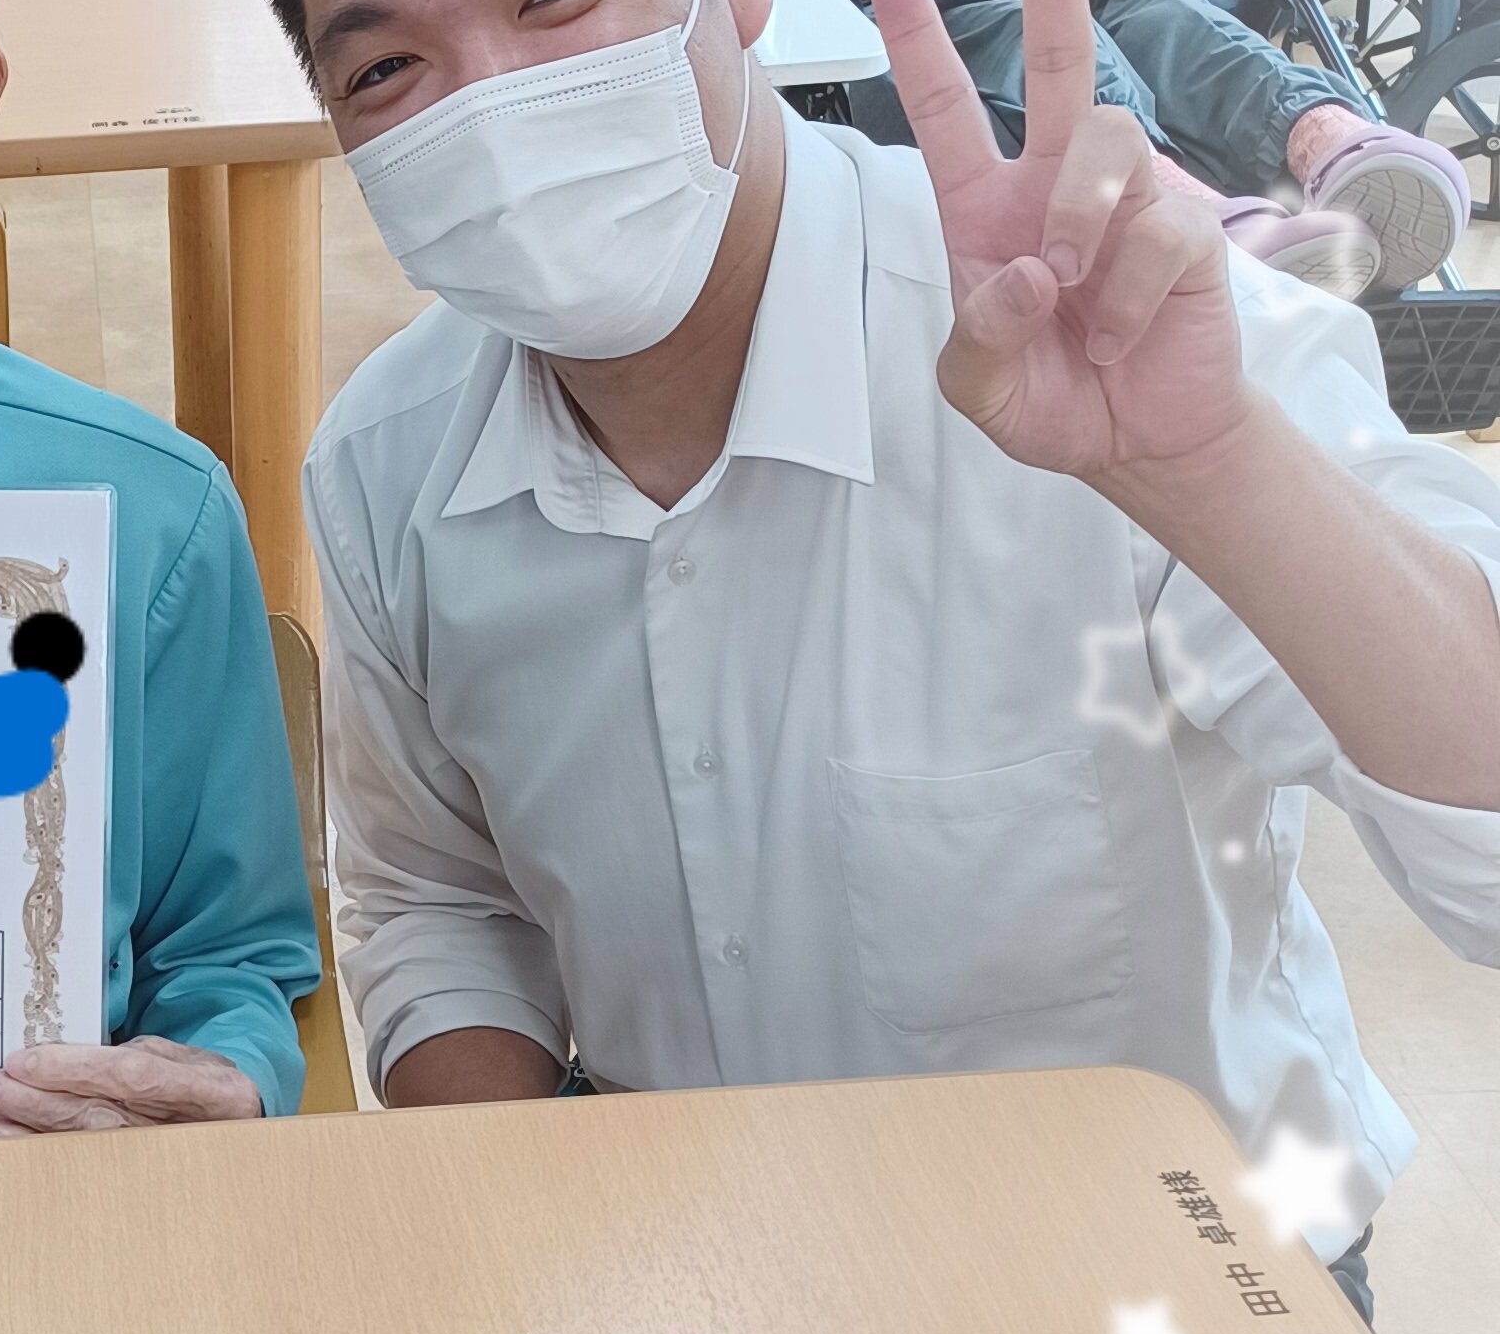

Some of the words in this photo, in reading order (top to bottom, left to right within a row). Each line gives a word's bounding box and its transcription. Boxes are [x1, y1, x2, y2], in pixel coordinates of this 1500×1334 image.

[1156, 1169, 1238, 1247] 卓雄様
[1225, 1263, 1291, 1317] 田中
